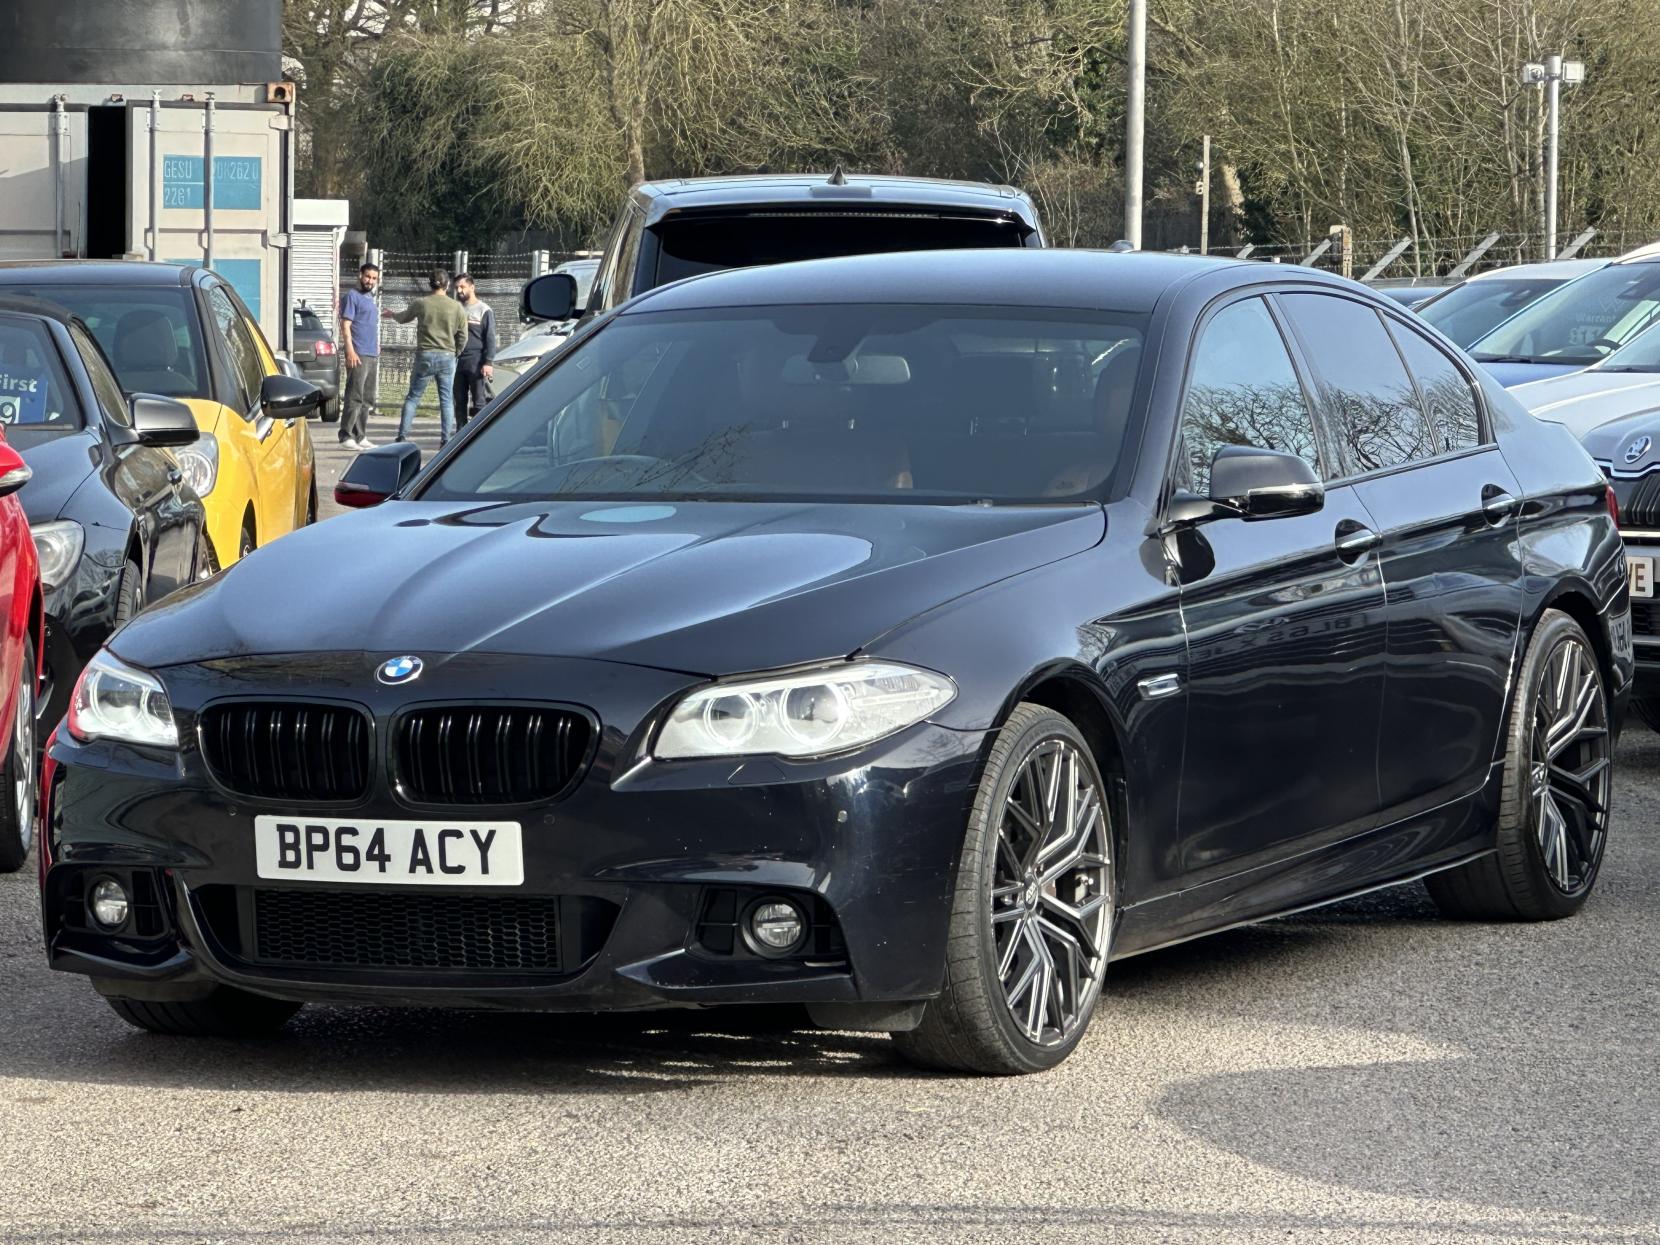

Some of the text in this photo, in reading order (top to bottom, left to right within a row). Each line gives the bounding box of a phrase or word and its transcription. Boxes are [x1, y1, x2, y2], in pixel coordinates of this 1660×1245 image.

[164, 160, 192, 179] GESU
[276, 823, 496, 875] BP64 ACY
